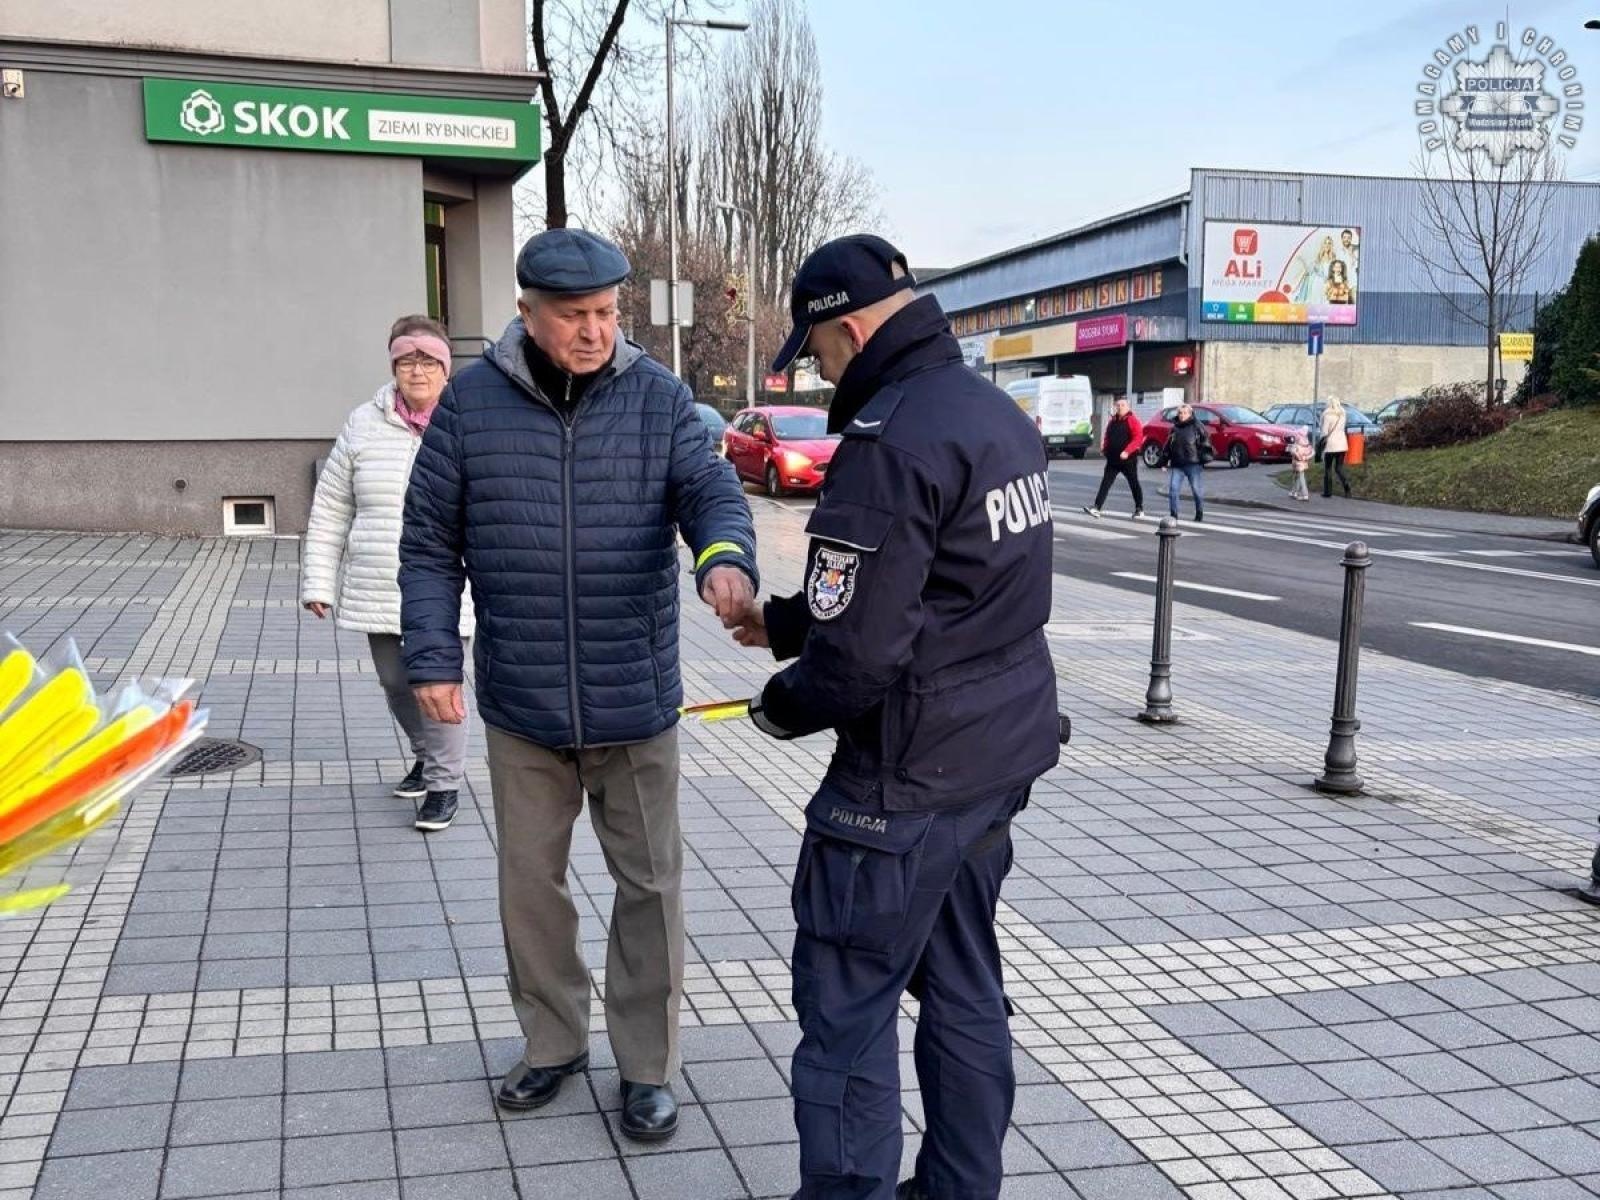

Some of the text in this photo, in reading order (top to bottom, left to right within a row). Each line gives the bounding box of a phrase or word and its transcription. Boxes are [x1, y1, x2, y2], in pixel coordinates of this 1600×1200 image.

[234, 102, 351, 140] SKOK
[377, 119, 510, 142] ZIEMI RYBNICKIEJ
[807, 291, 850, 313] POLICJA
[830, 807, 888, 834] POLICJA
